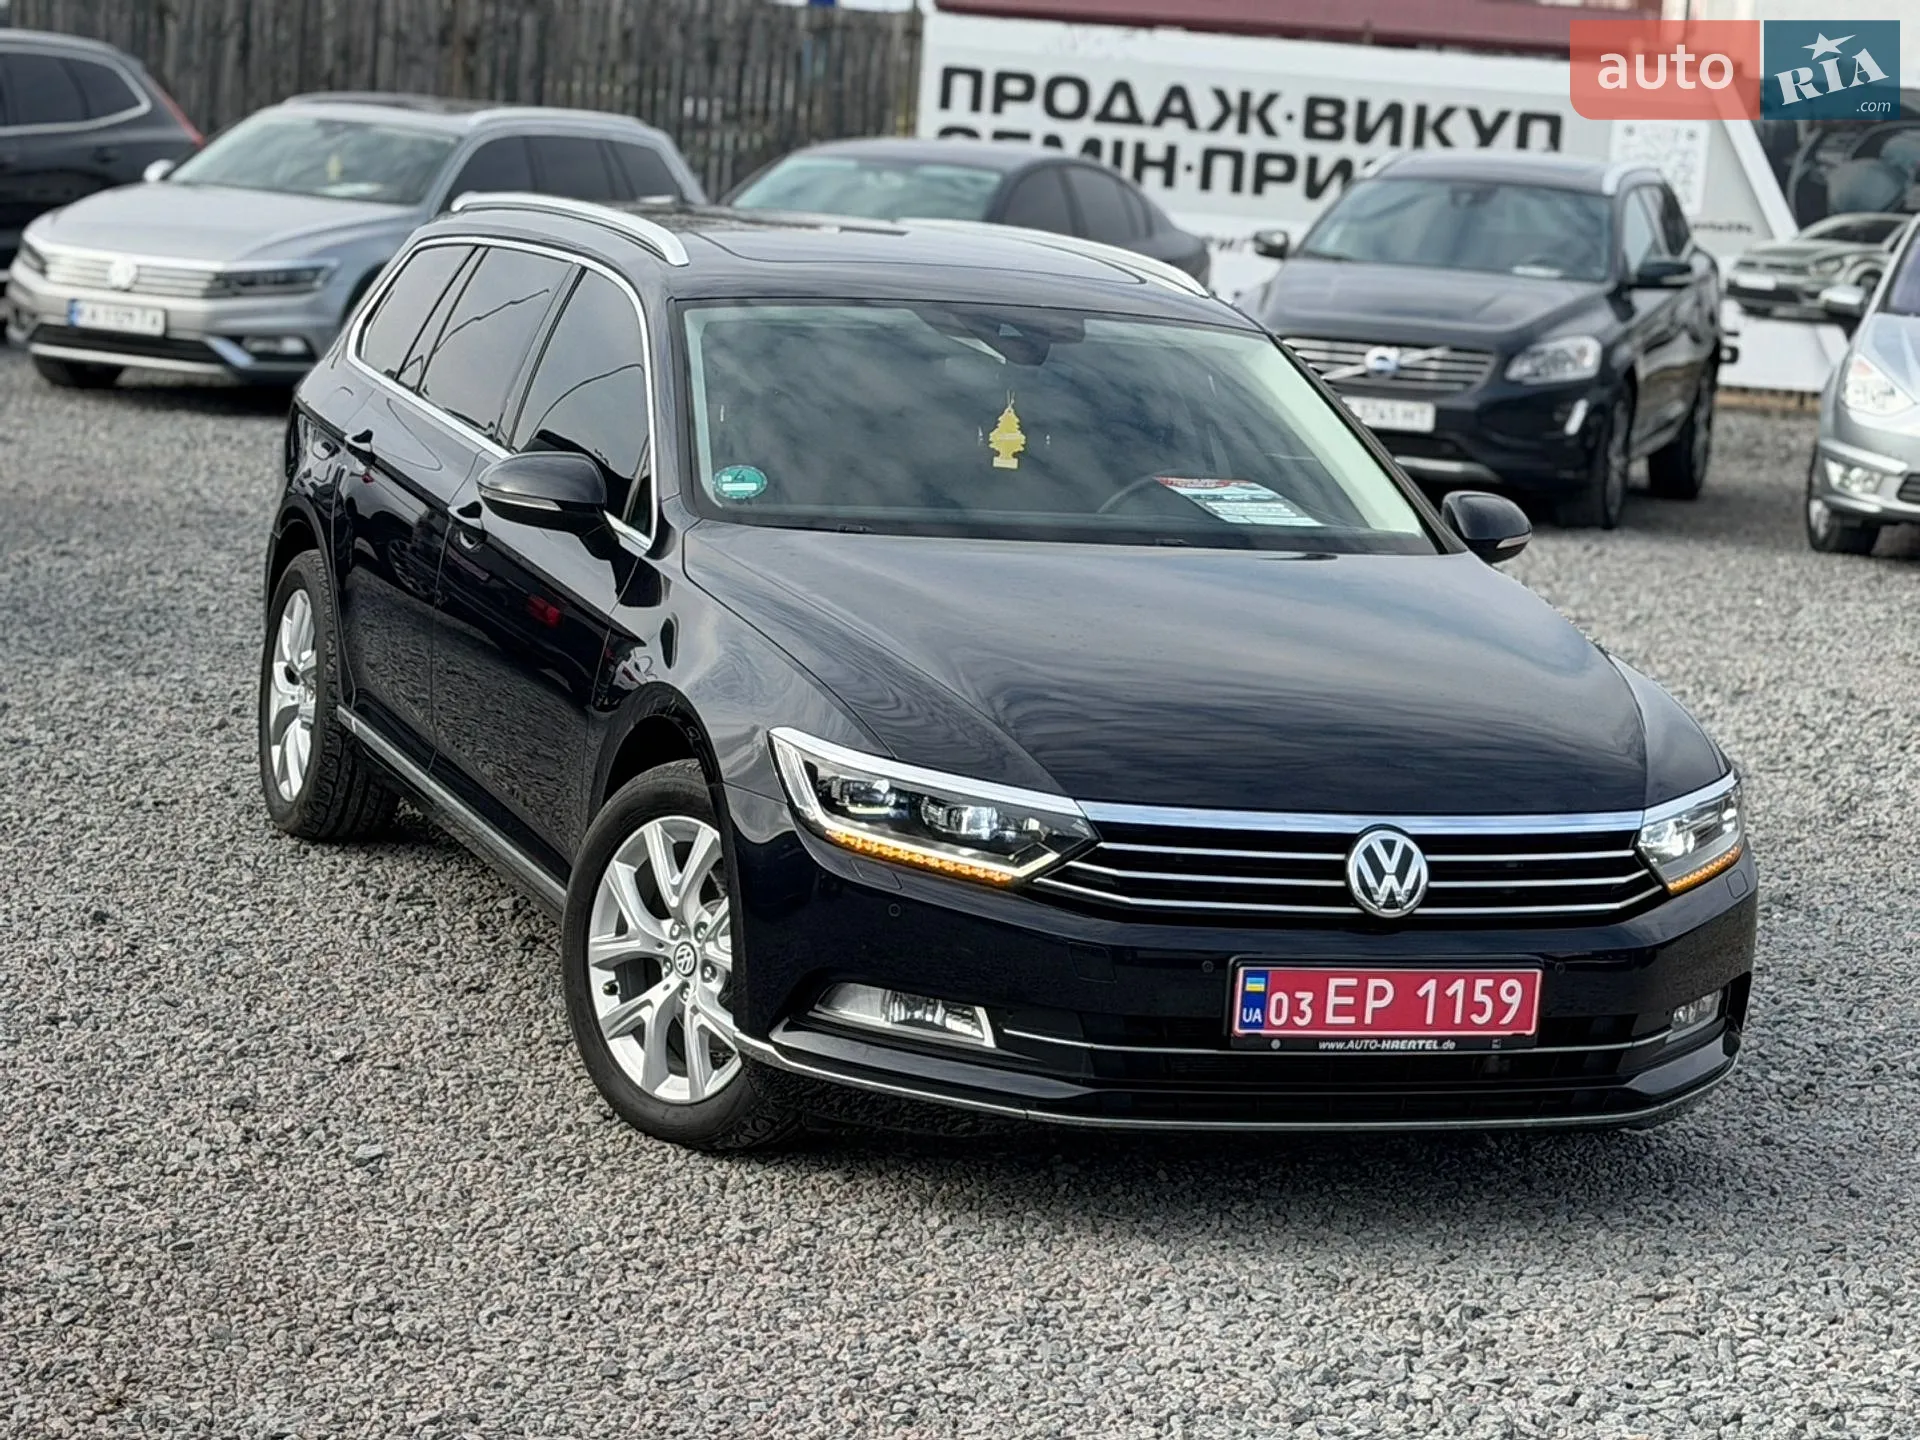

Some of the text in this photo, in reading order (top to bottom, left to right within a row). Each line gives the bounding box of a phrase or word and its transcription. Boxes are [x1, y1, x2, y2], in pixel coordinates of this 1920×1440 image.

[1269, 977, 1523, 1027] 03 EP 1159
[1242, 1008, 1262, 1023] UA
[1318, 1039, 1456, 1050] www.AUTO-HAERTEL.de
